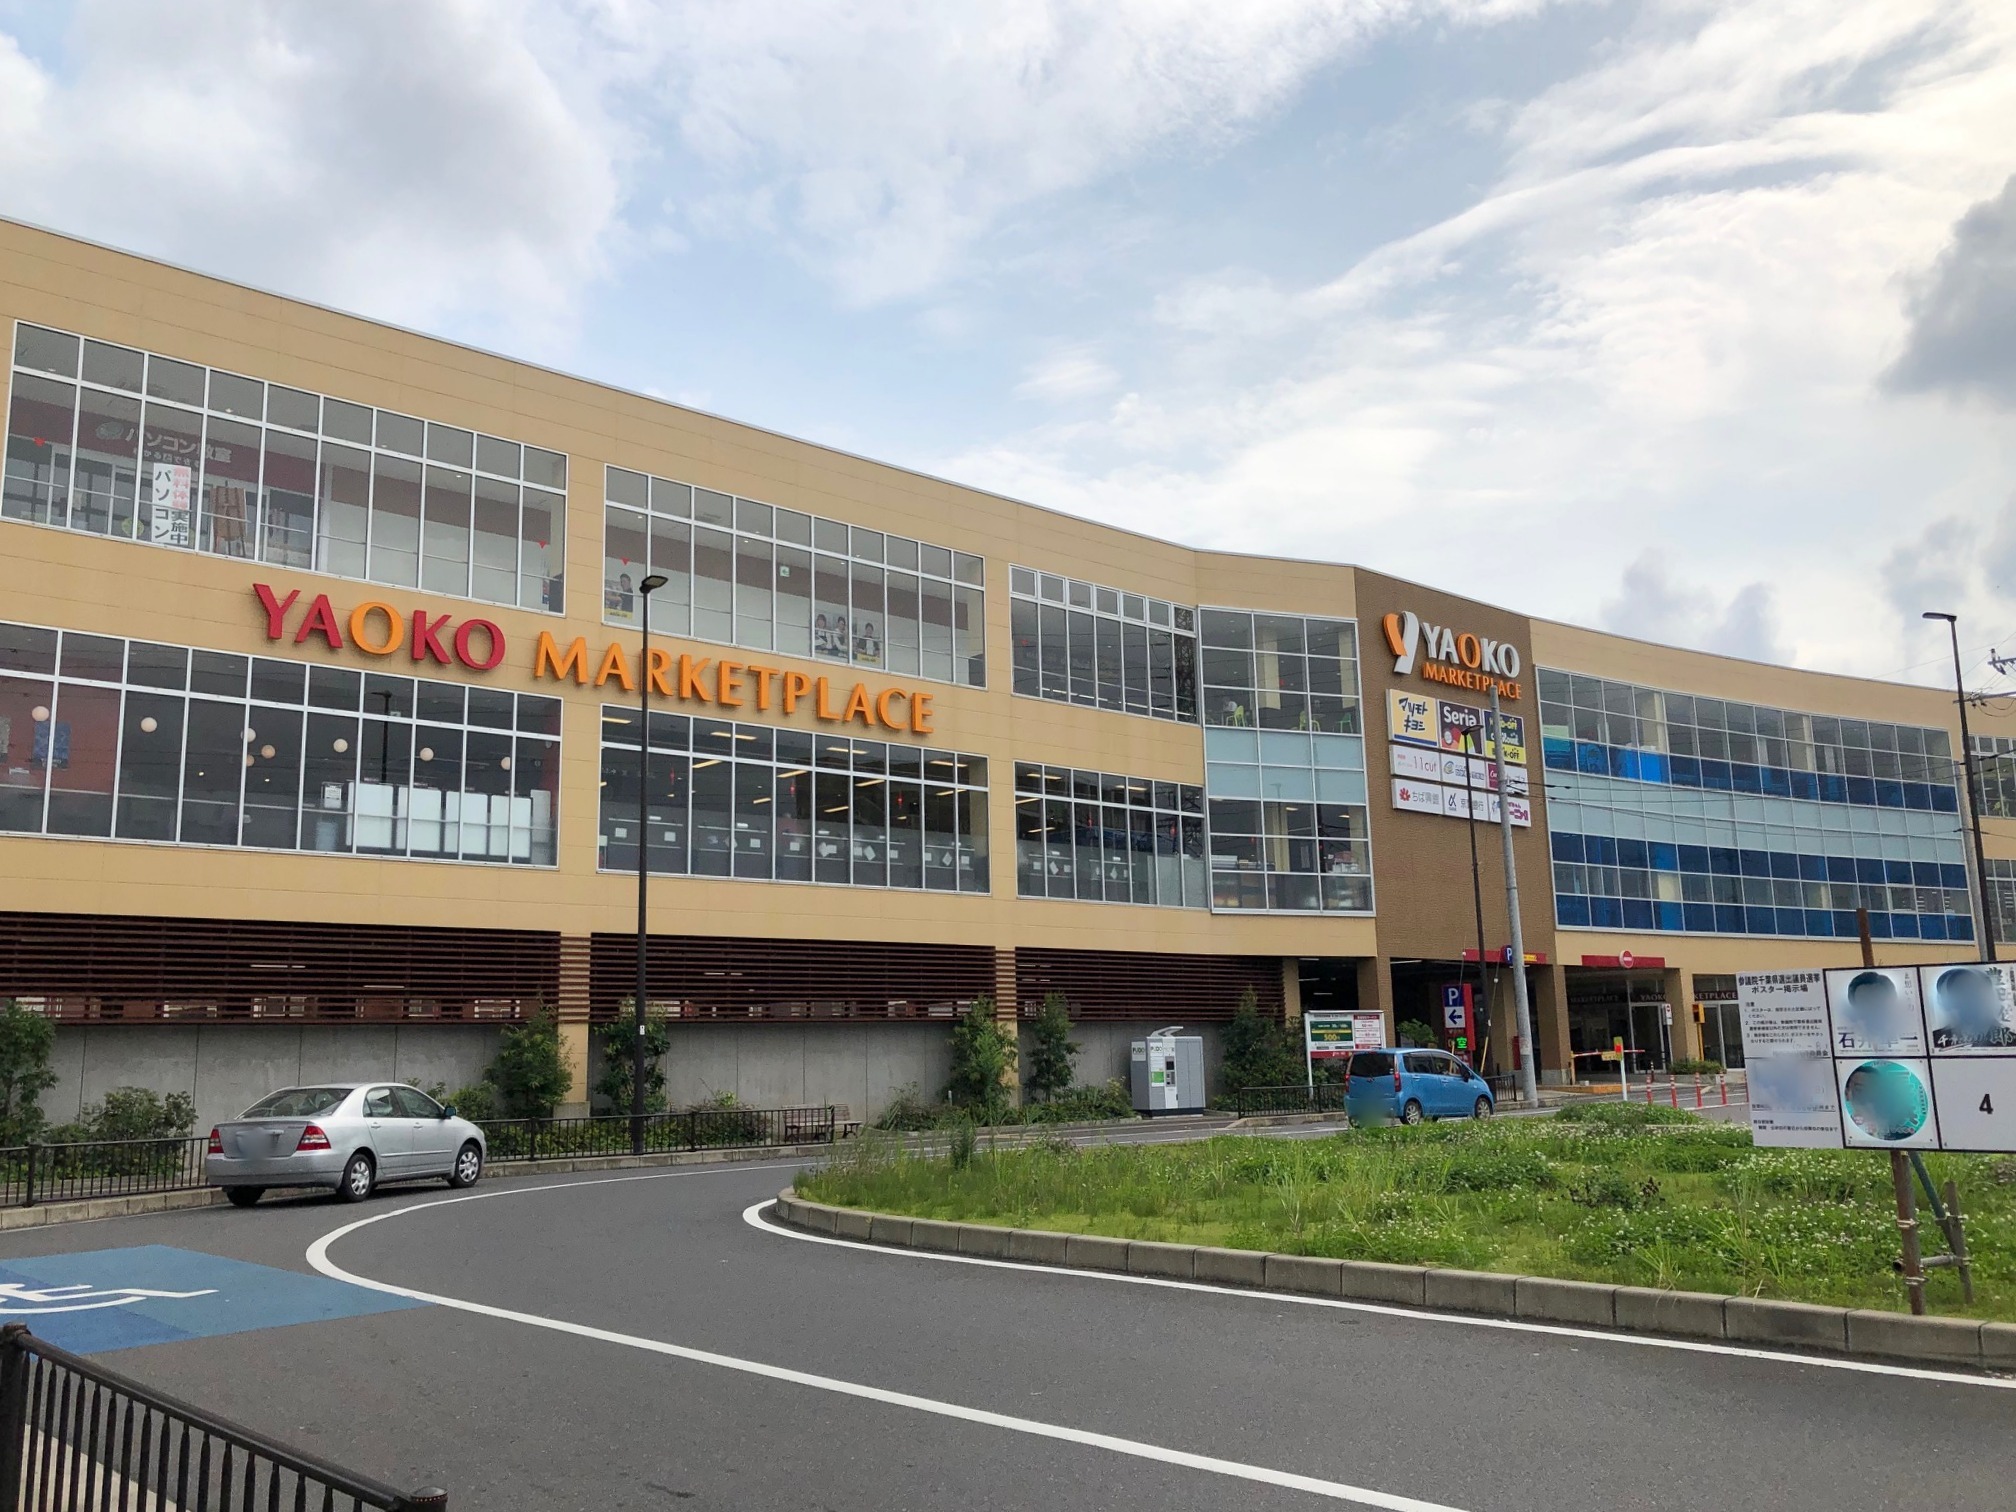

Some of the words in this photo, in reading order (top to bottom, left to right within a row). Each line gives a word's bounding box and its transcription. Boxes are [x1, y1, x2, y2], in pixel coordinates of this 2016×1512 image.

[154, 470, 172, 538] パソコン
[253, 583, 506, 670] YAOKO
[535, 630, 935, 734] MARKETPLACE
[1421, 622, 1520, 678] YAOKO
[1398, 697, 1428, 717] マツモト
[1443, 706, 1477, 727] Seria
[1403, 715, 1426, 733] キヨシ
[1460, 798, 1484, 812] 京銀行
[1506, 947, 1513, 961] P
[1448, 988, 1459, 1006] P
[1751, 984, 1809, 994] ポスター掲示場
[1838, 1031, 1918, 1049] 石一
[1978, 1093, 1994, 1115] 4
